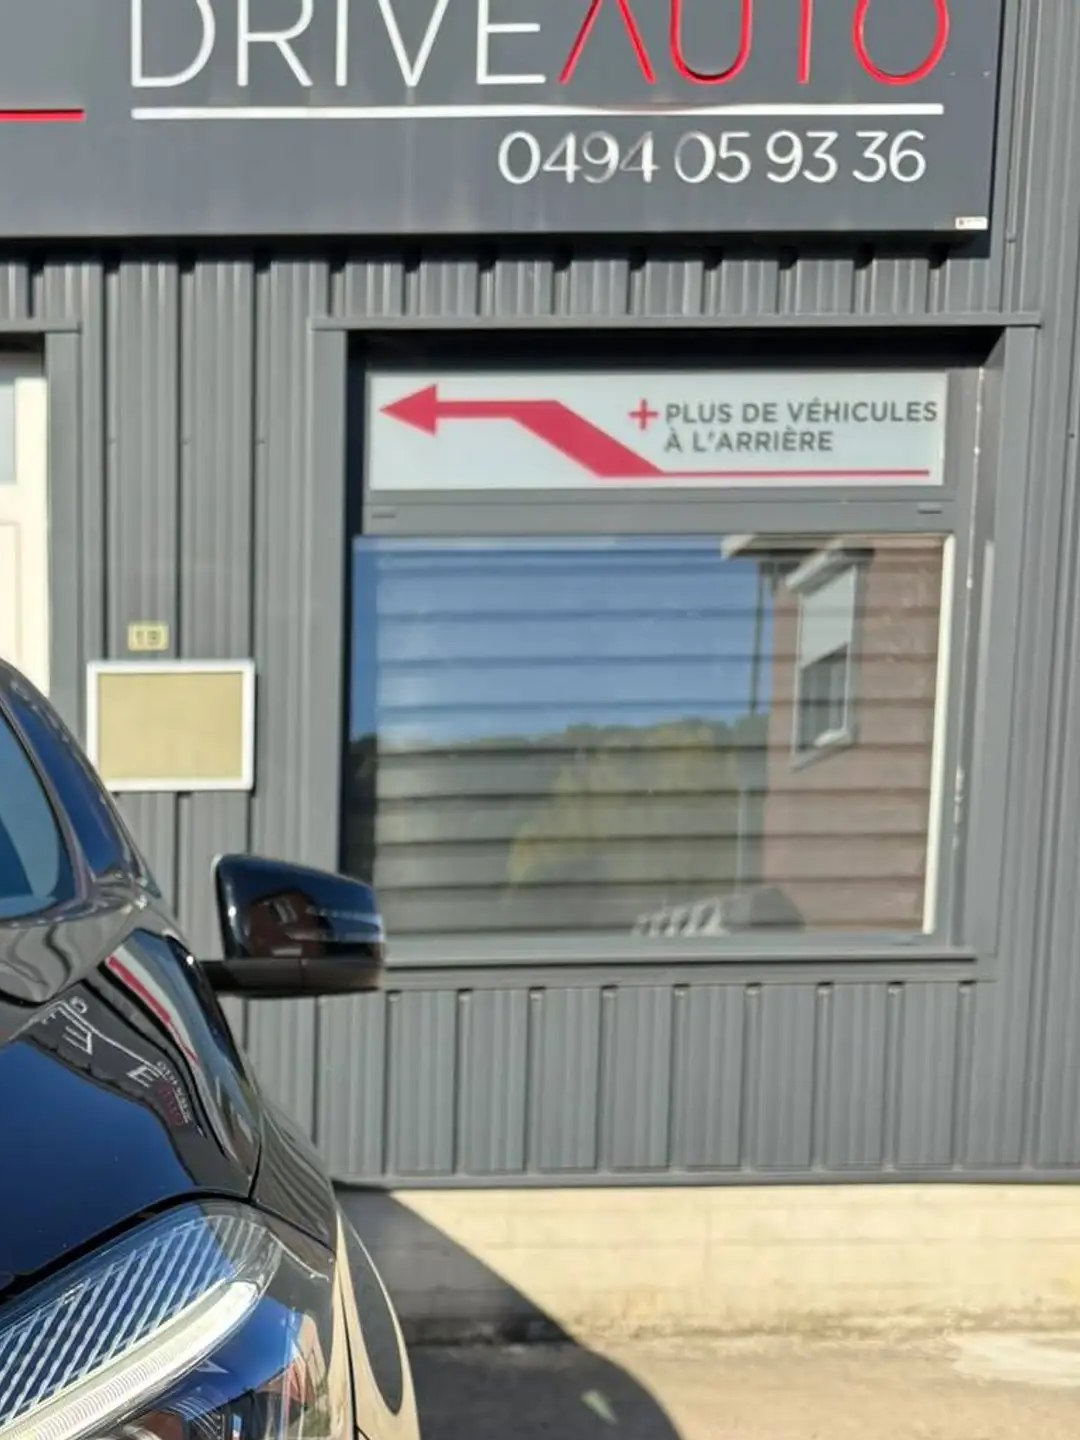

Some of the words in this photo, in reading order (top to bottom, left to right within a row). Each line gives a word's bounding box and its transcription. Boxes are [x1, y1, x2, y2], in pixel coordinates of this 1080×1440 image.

[497, 130, 659, 184] 0494
[674, 131, 752, 184] 05
[765, 130, 839, 183] 93
[852, 129, 927, 183] 36
[665, 402, 732, 424] PLUS
[742, 402, 778, 423] DE
[787, 396, 938, 423] VÉHICULES
[664, 425, 683, 452] À
[692, 425, 834, 452] L'ARRIÈRE
